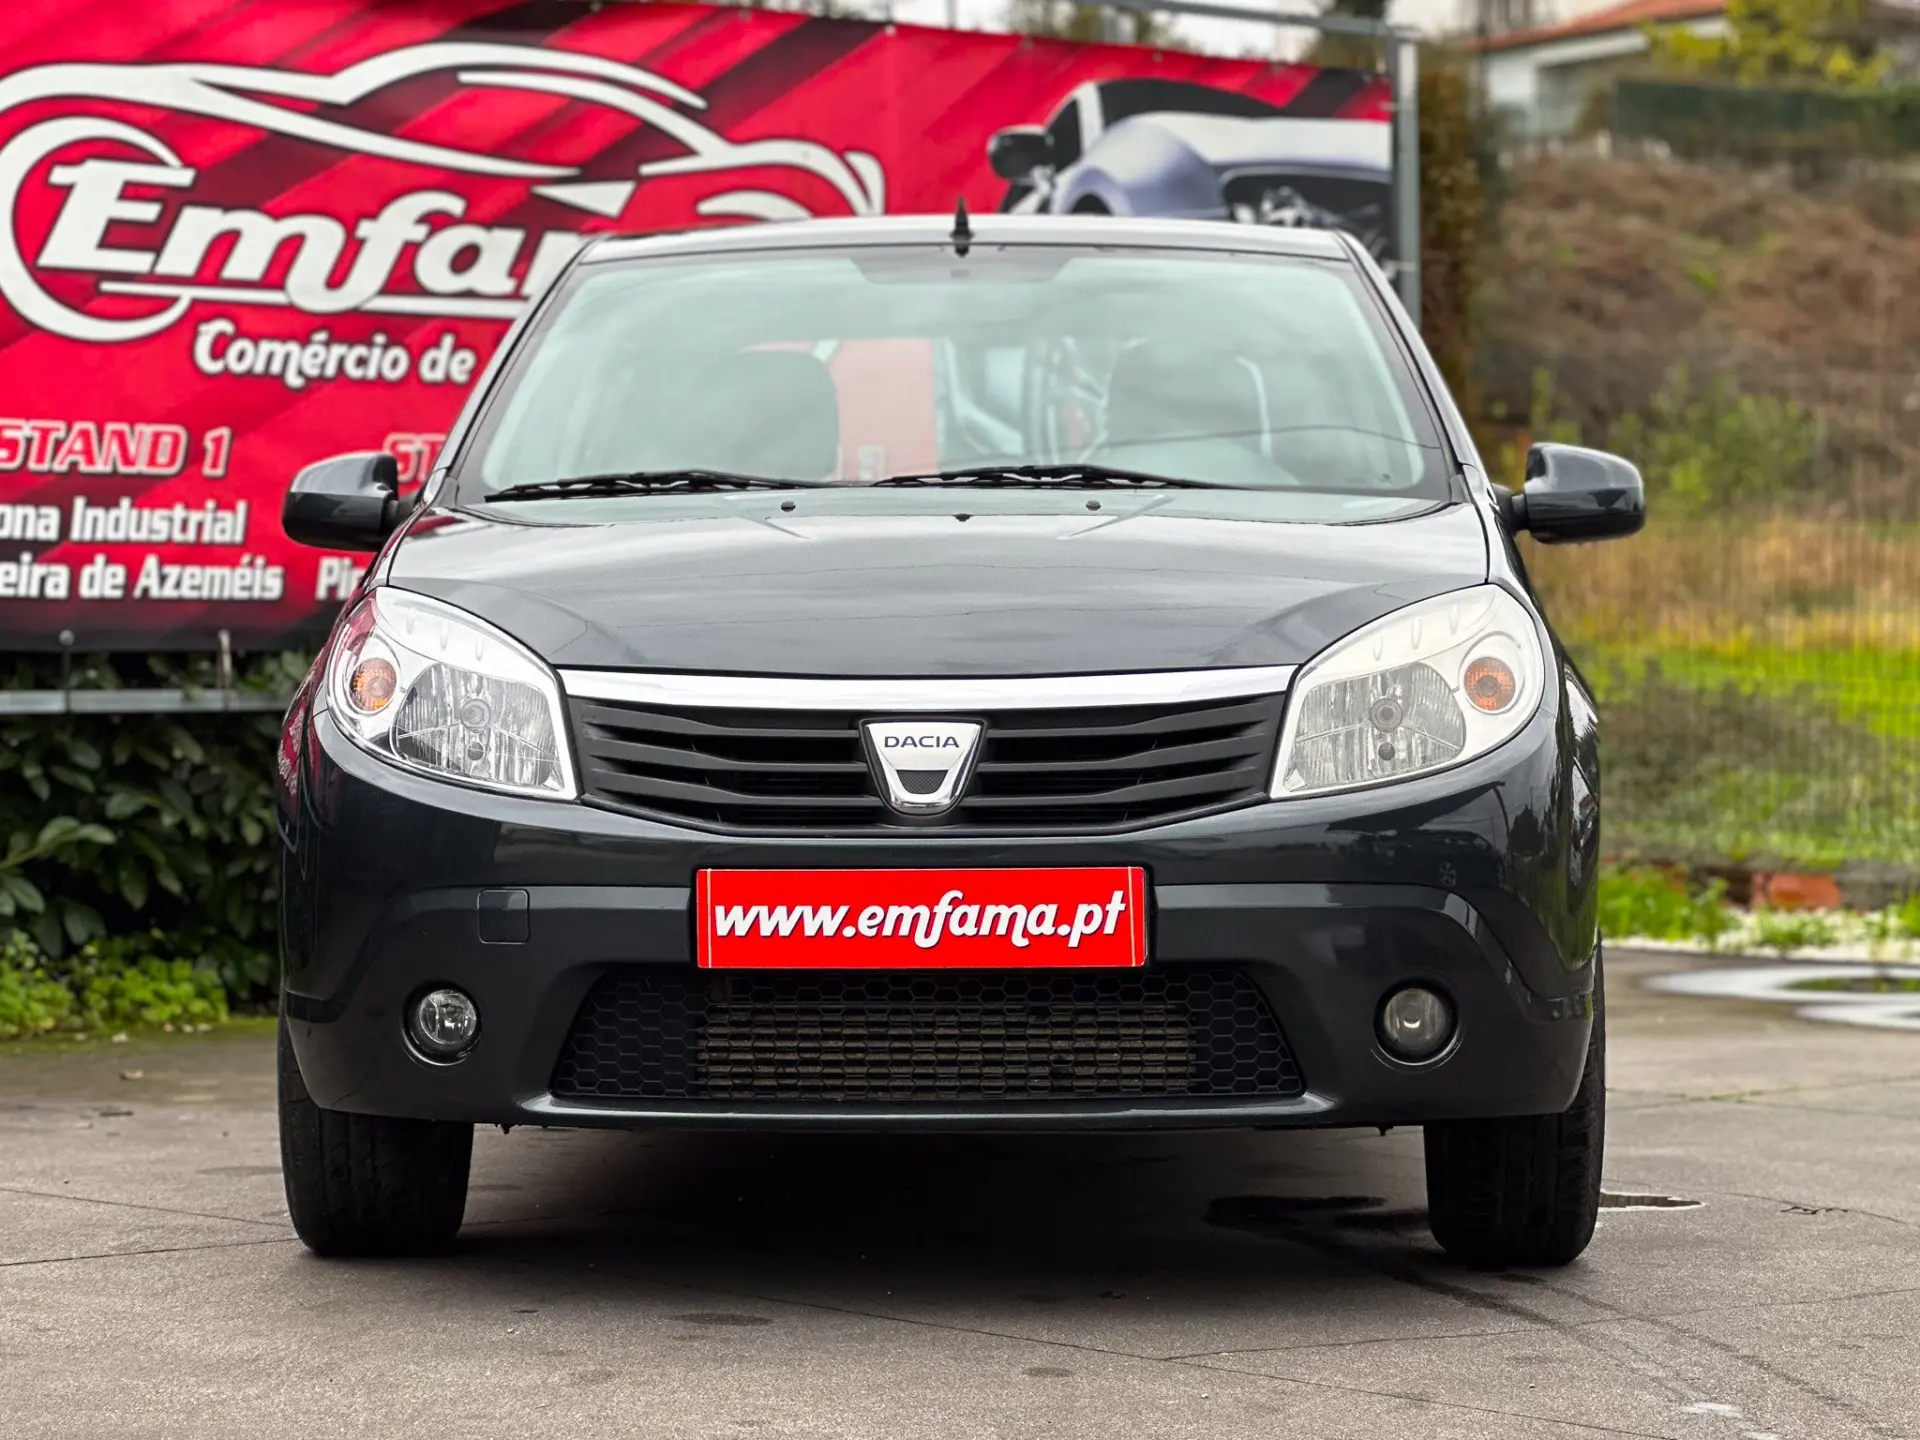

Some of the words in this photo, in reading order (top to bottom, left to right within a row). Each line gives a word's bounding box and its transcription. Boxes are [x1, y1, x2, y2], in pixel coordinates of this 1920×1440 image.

[193, 317, 411, 388] Comércio
[418, 332, 477, 384] de
[0, 418, 188, 476] STAND
[201, 426, 232, 478] 1
[69, 495, 247, 544] Industrial
[0, 552, 70, 599] eira
[78, 553, 127, 598] de
[133, 553, 284, 600] Azeméis
[884, 735, 960, 748] DACIA
[714, 890, 1126, 949] www.emfama.pt
